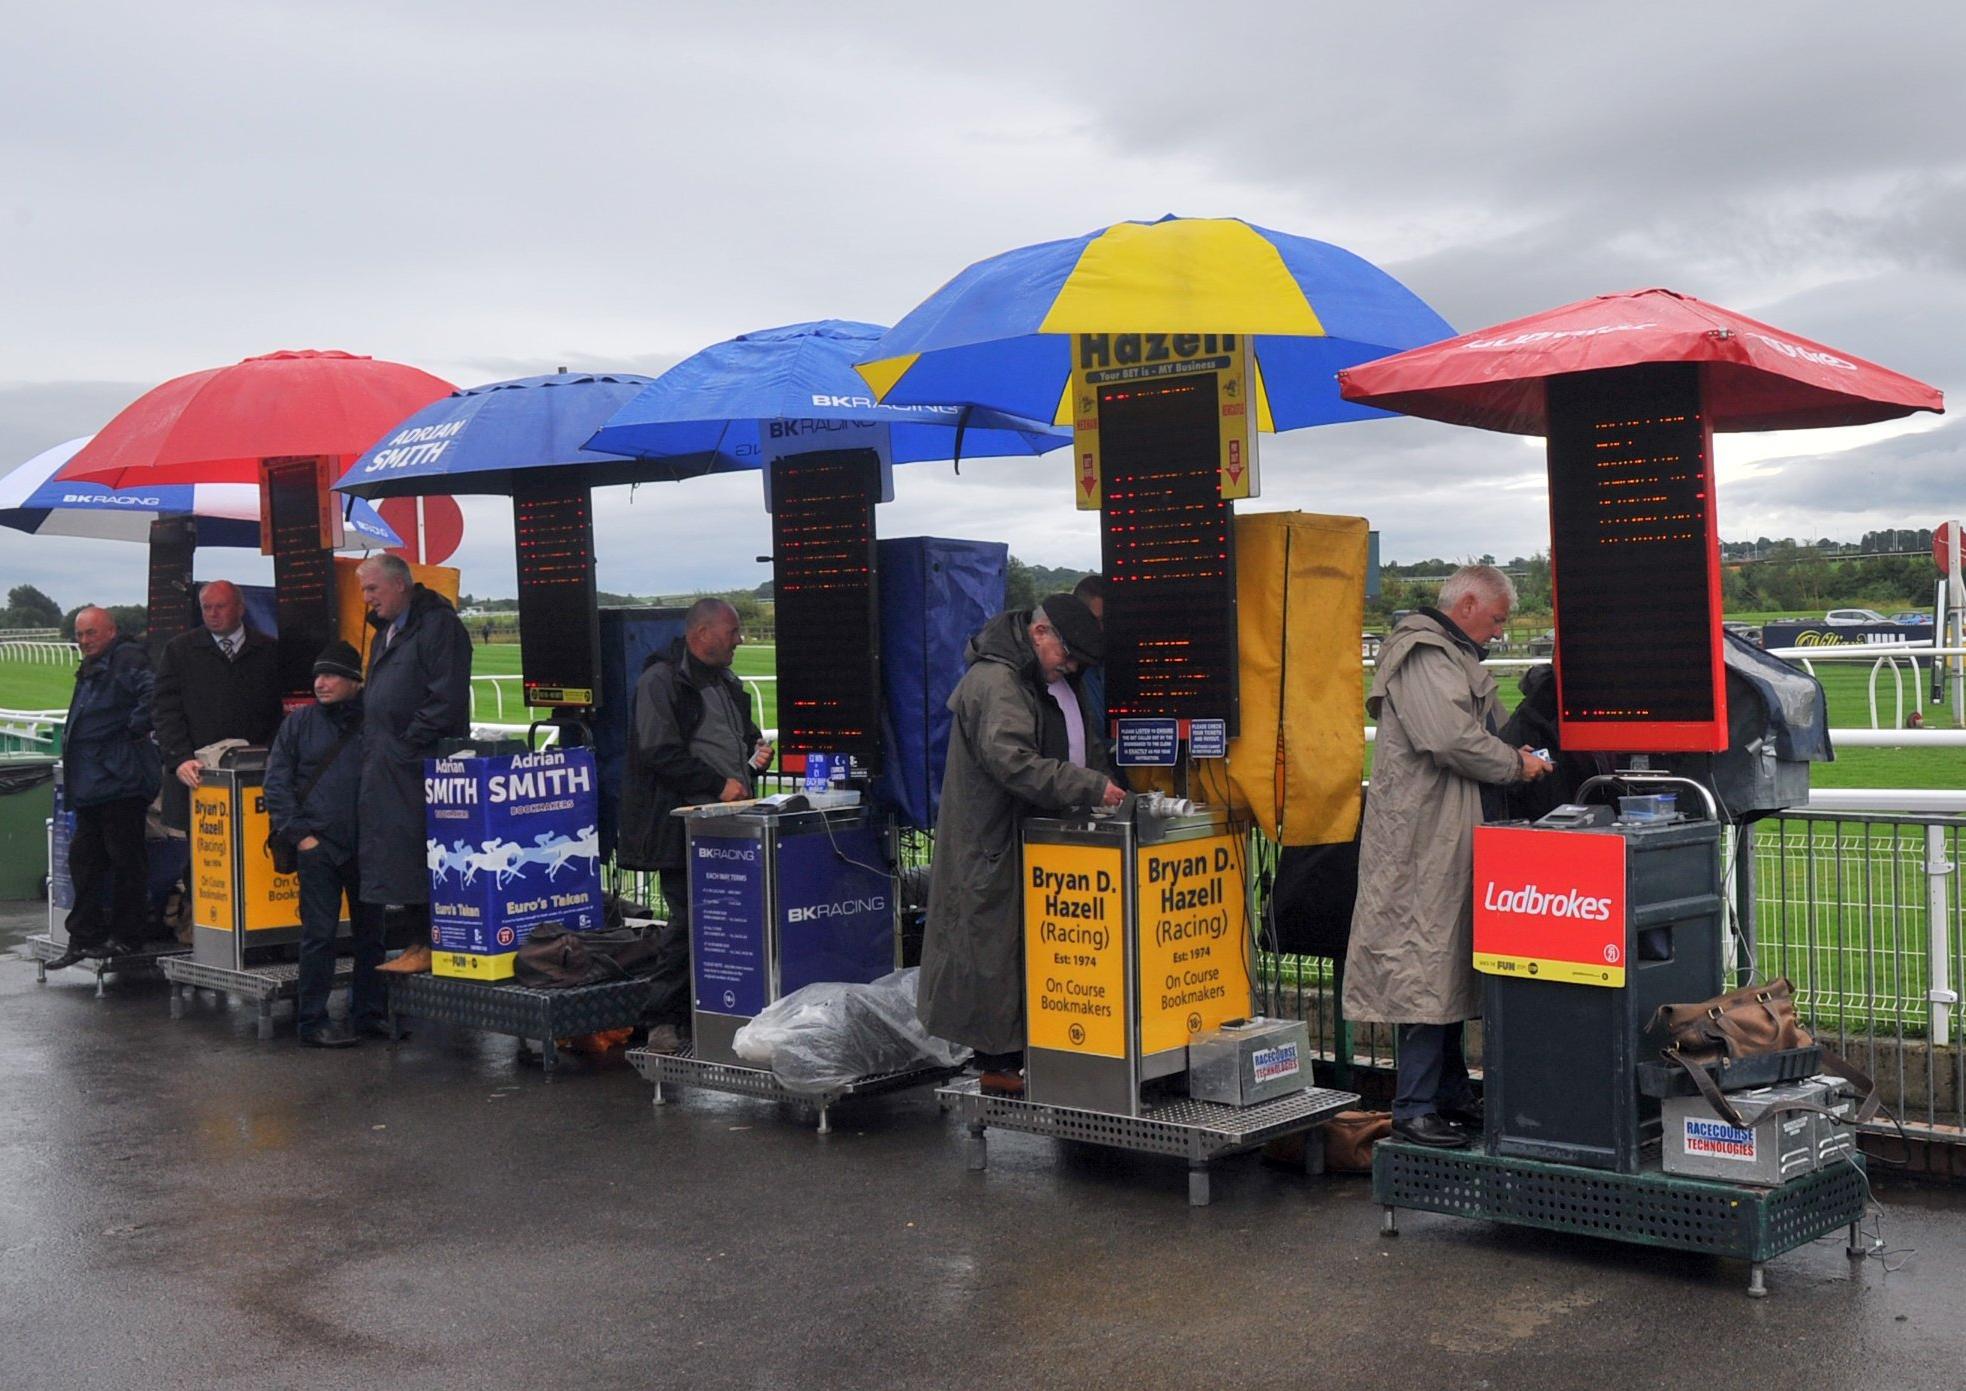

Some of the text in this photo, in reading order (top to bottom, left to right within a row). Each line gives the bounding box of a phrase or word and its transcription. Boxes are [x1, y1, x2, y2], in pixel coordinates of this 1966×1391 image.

[1100, 371, 1120, 381] Your
[1141, 367, 1150, 376] is
[1158, 364, 1173, 374] MY
[1176, 360, 1216, 372] Business
[388, 419, 467, 446] ADRIAN
[365, 440, 450, 472] SMITH
[436, 758, 465, 774] Adrian
[510, 752, 565, 770] Adrian
[424, 778, 478, 804] SMITH
[488, 766, 590, 803] SMITH
[195, 799, 228, 820] Bryan D.
[510, 800, 575, 816] BOOKMAKERS
[199, 820, 224, 836] Hazell
[197, 837, 226, 856] (Racing)
[1149, 848, 1234, 886] Bryan D.
[273, 877, 290, 888] On
[1032, 866, 1116, 895] Bryan D.
[506, 892, 590, 916] Euro's Taken
[1162, 878, 1222, 914] Hazell
[1484, 882, 1612, 922] Ladbrokes
[434, 902, 480, 918] Euro's Taken
[1046, 894, 1104, 920] Hazell
[1040, 920, 1110, 950] (Racing)
[1156, 909, 1228, 948] (Racing)
[1054, 953, 1096, 966] Est: 1974
[1173, 946, 1210, 963] Est: 1974
[1497, 960, 1515, 971] FUN
[1046, 978, 1105, 998] On Course
[1166, 967, 1219, 990] On Course
[1042, 996, 1111, 1017] Bookmakers
[1162, 984, 1225, 1010] Bookmakers
[1255, 1046, 1296, 1066] RACECOURSE
[1256, 1060, 1297, 1079] TECHNOLOGIES
[1687, 1122, 1753, 1140] RACECOURSE
[1687, 1138, 1754, 1156] TECHNOLOGIES
